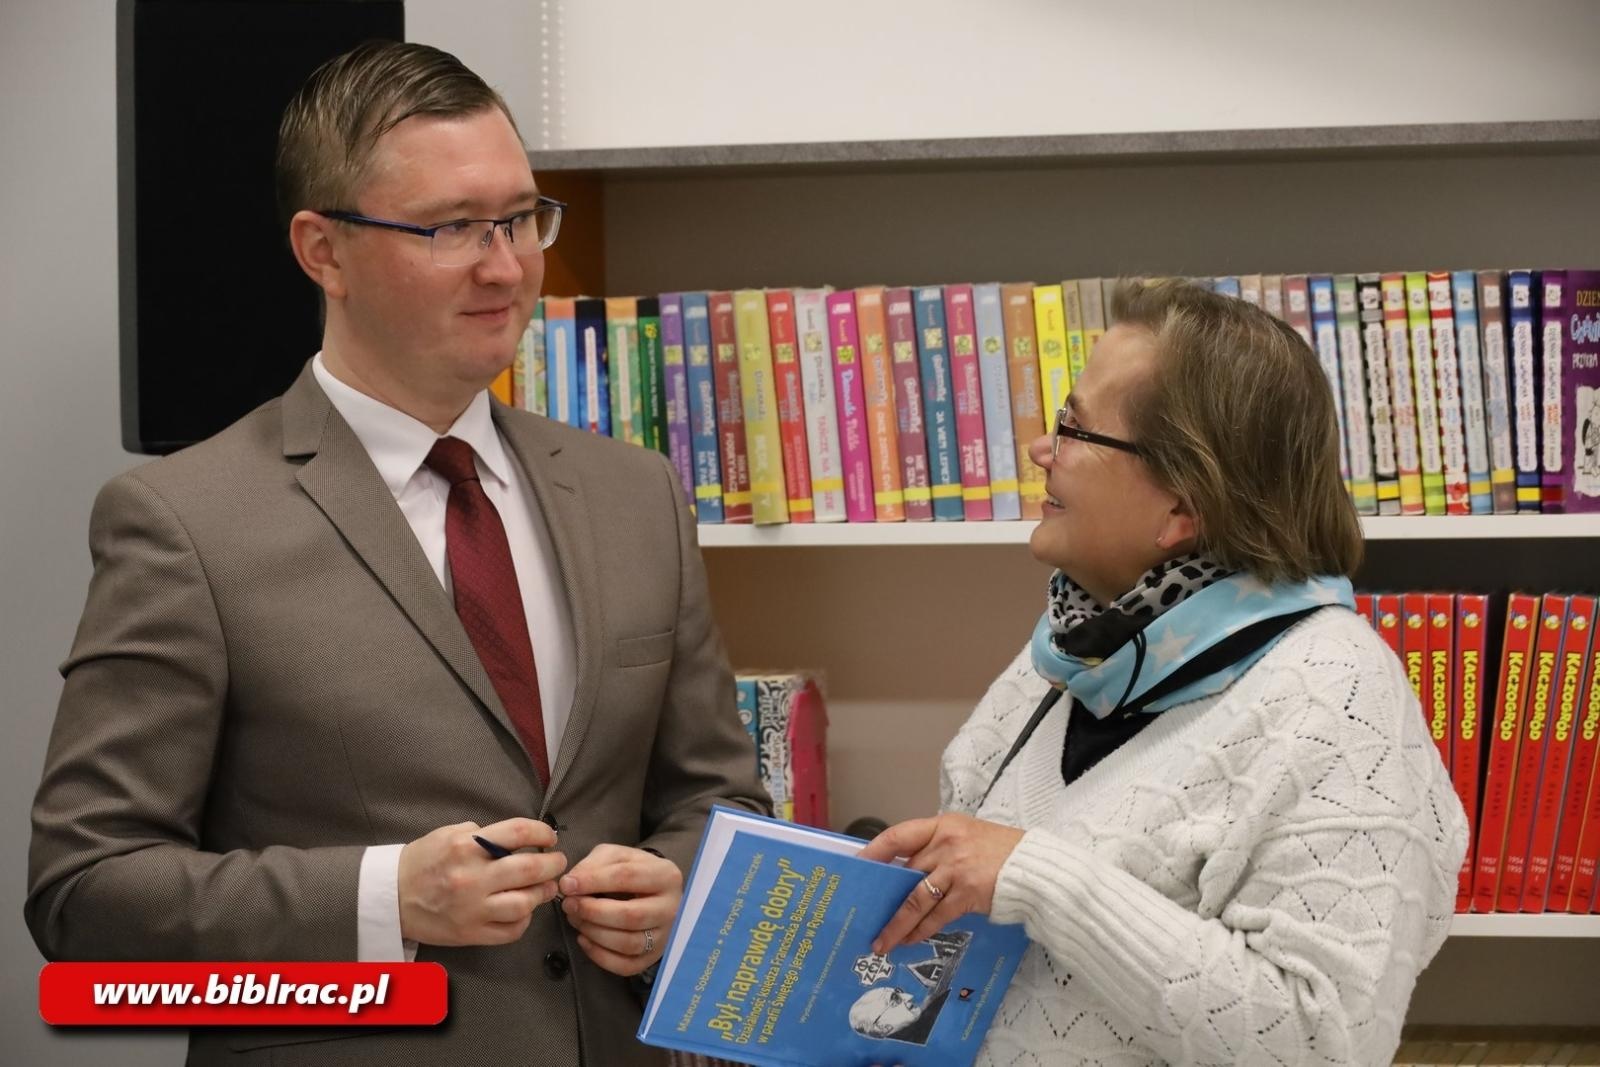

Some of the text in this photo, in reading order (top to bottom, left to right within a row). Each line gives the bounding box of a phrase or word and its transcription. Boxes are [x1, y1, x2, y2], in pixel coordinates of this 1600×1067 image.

[1431, 650, 1448, 740] KACZOGRÓD
[1461, 650, 1478, 740] KACZOGRÓD
[1500, 651, 1523, 741] KACZOGRÓD
[1529, 651, 1554, 741] KACZOGRÓD
[1555, 651, 1582, 741] KACZOGRÓD
[677, 853, 763, 1032] Mateusz Sobeczko Patrycja Tomiczek
[706, 1001, 744, 1043] „Był
[726, 916, 786, 1004] naprawdę
[734, 865, 828, 1045] Działalność księdza Franciszka Blachnickiego
[757, 873, 842, 1044] w parafii Świętego Jerzego w Rydułtowach
